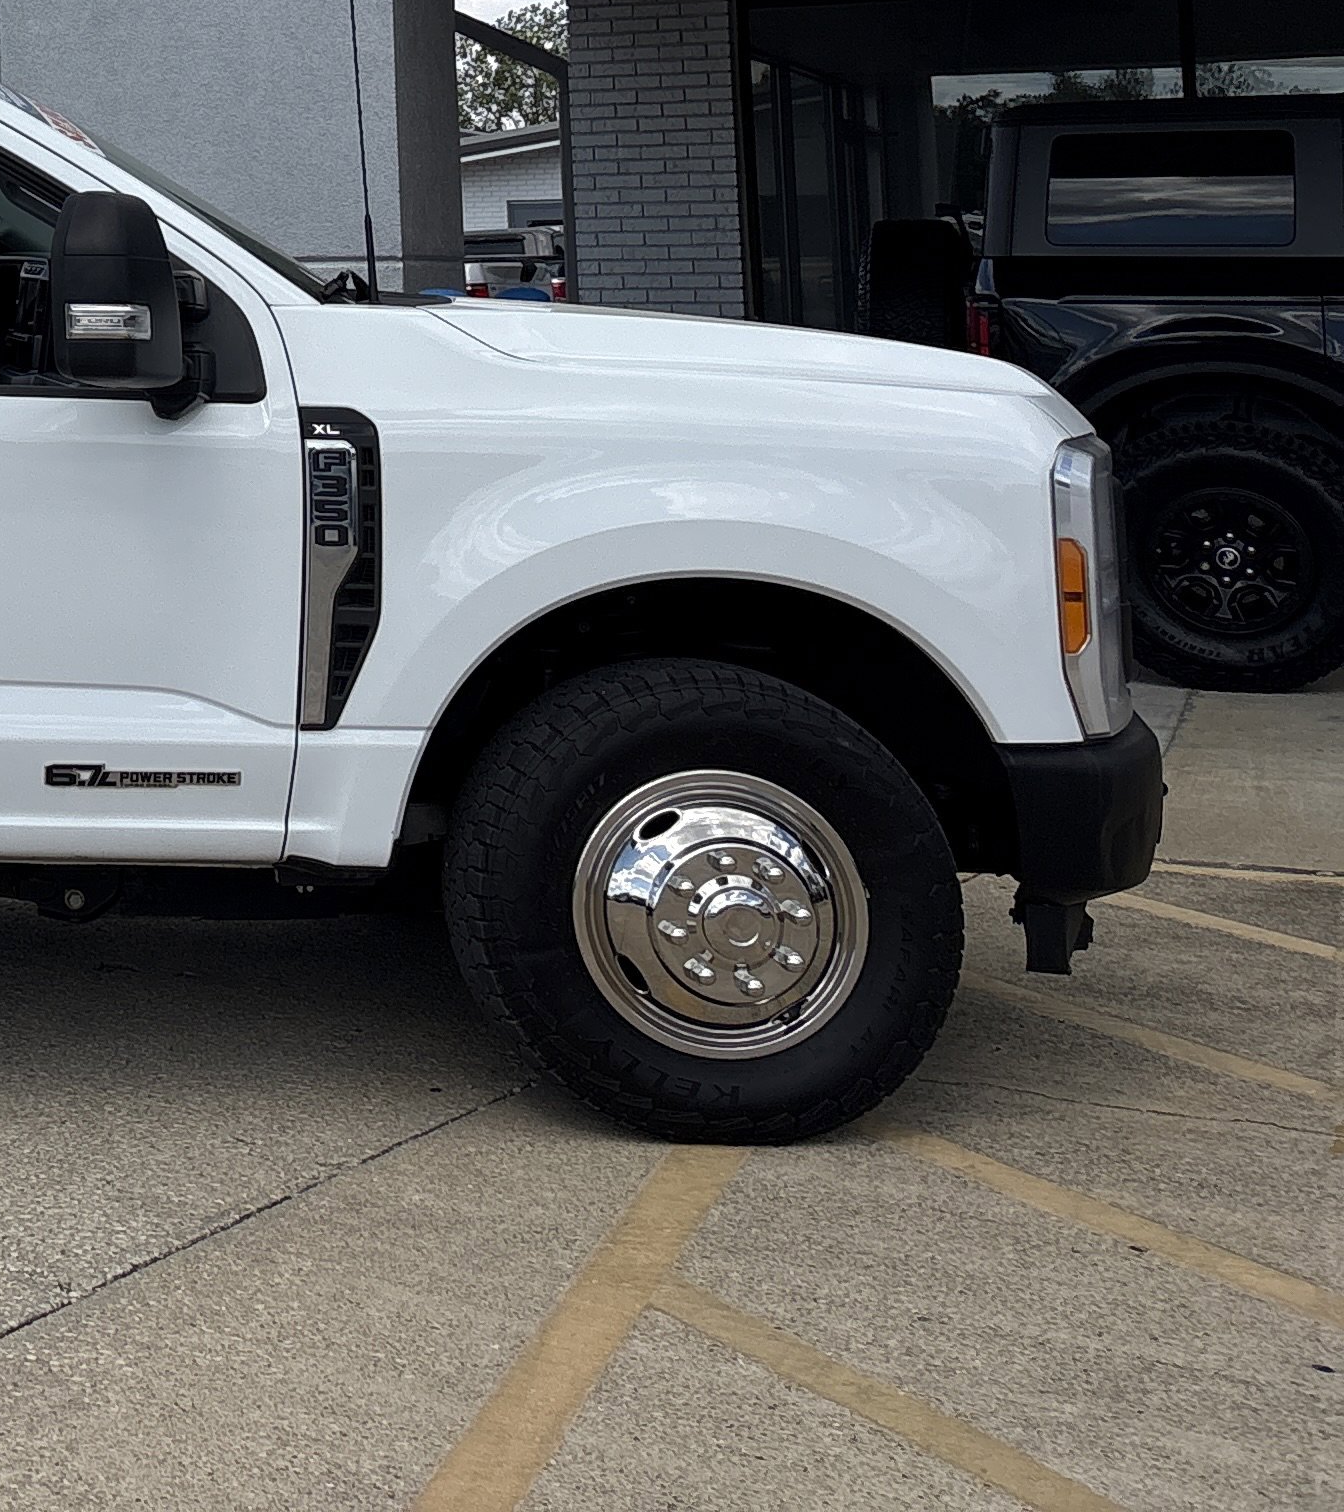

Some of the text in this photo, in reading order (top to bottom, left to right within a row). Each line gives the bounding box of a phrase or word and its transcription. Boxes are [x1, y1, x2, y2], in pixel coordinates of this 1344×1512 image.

[312, 423, 340, 435] XL
[312, 450, 350, 547] F350
[45, 764, 237, 787] 6.7L POWER STROKE
[583, 1033, 741, 1108] KELLY
